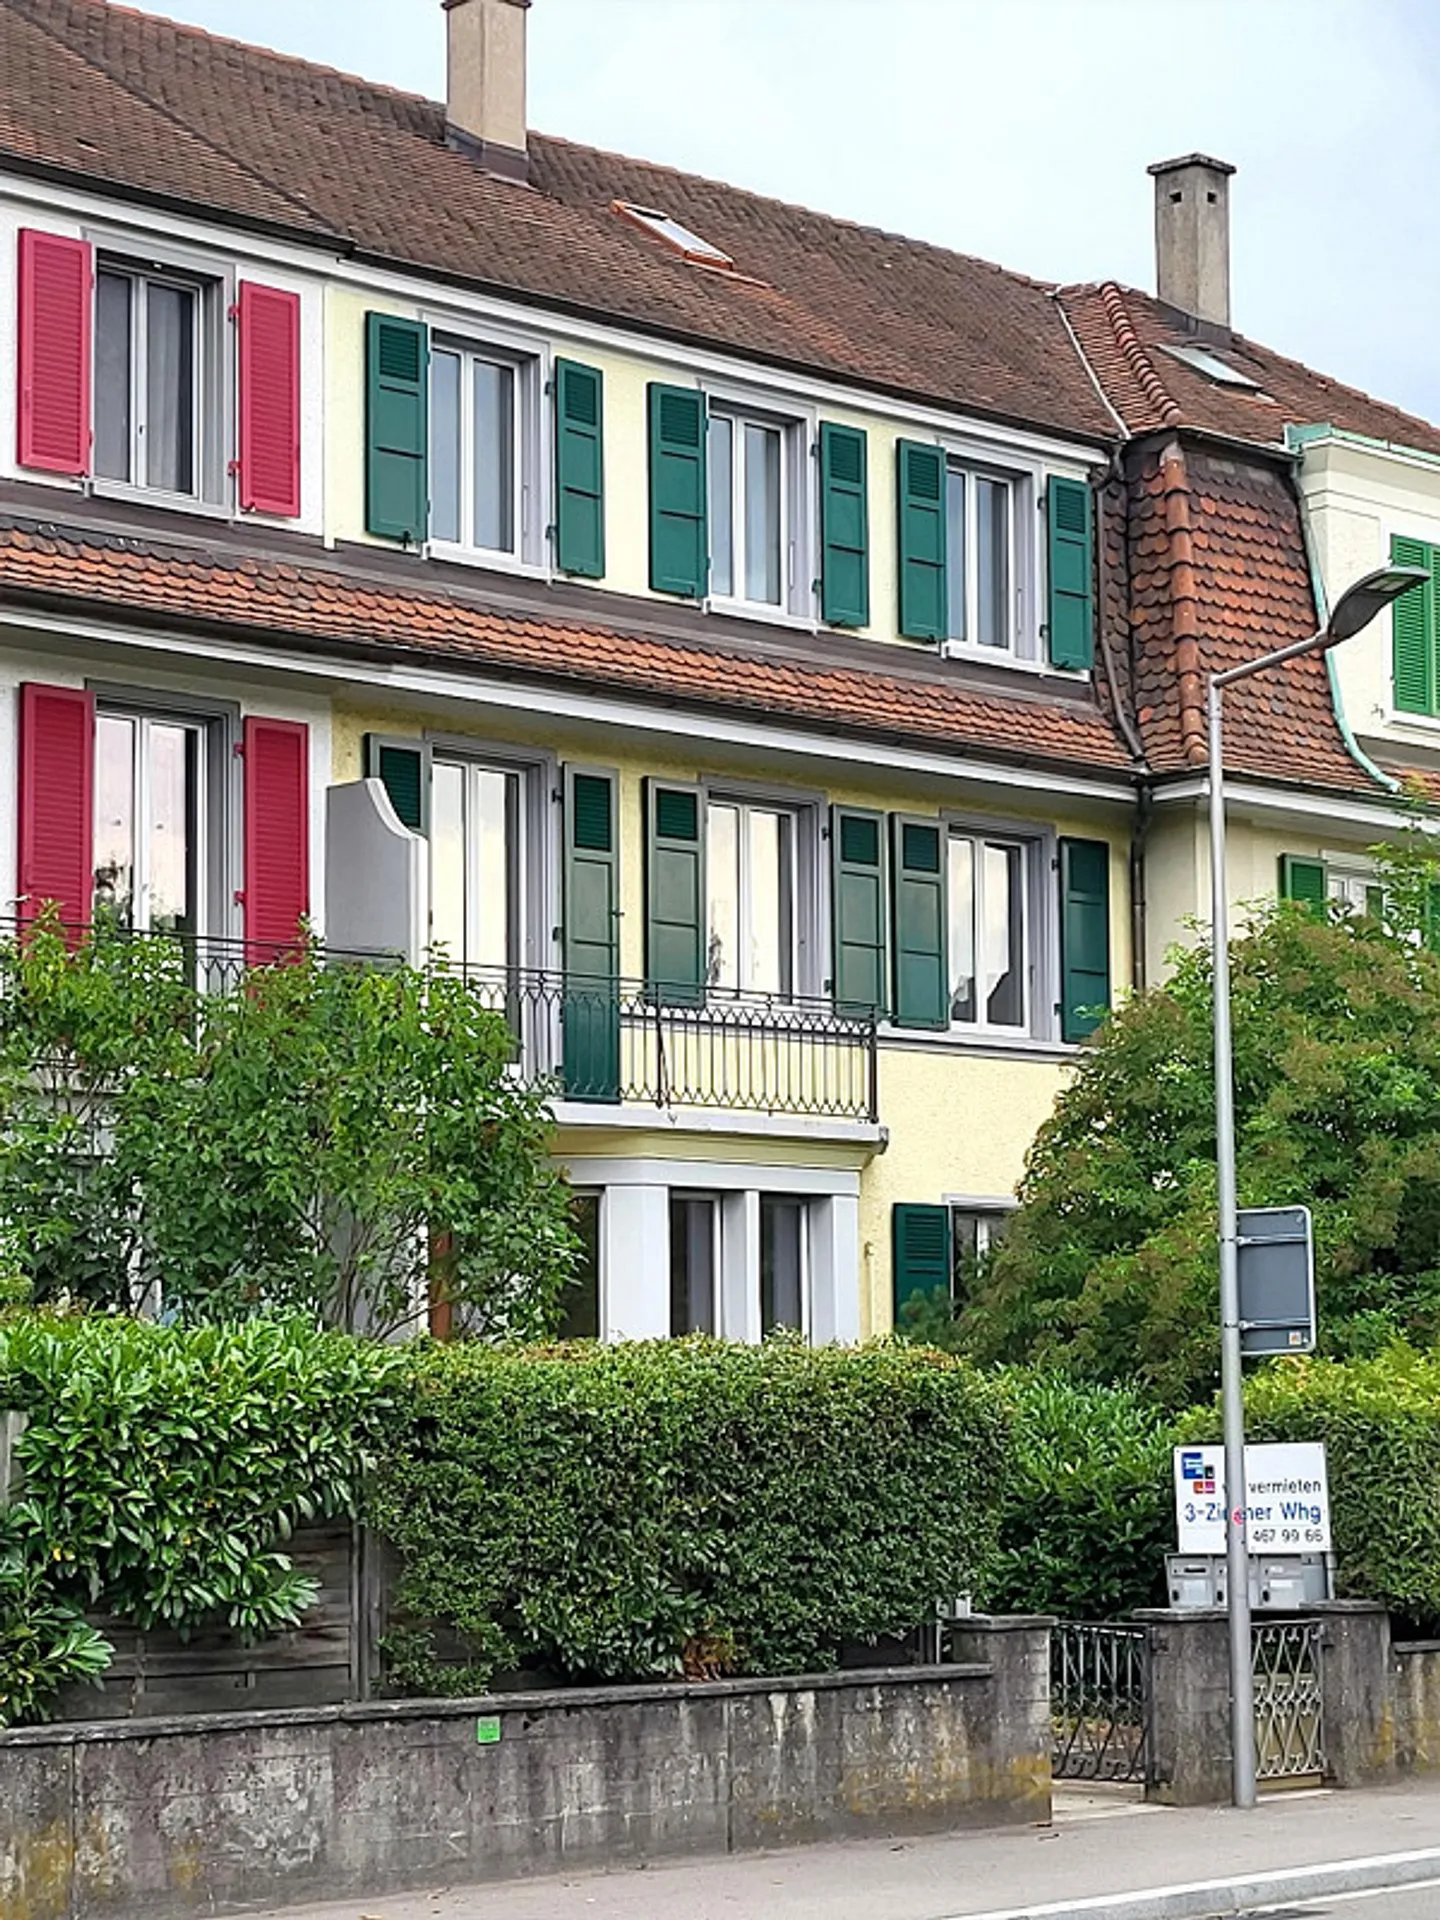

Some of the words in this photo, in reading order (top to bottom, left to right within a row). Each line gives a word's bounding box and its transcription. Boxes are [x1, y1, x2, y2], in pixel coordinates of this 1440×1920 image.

[1248, 1478, 1322, 1494] vermieten
[1279, 1501, 1322, 1525] Whg
[1281, 1528, 1300, 1543] 99
